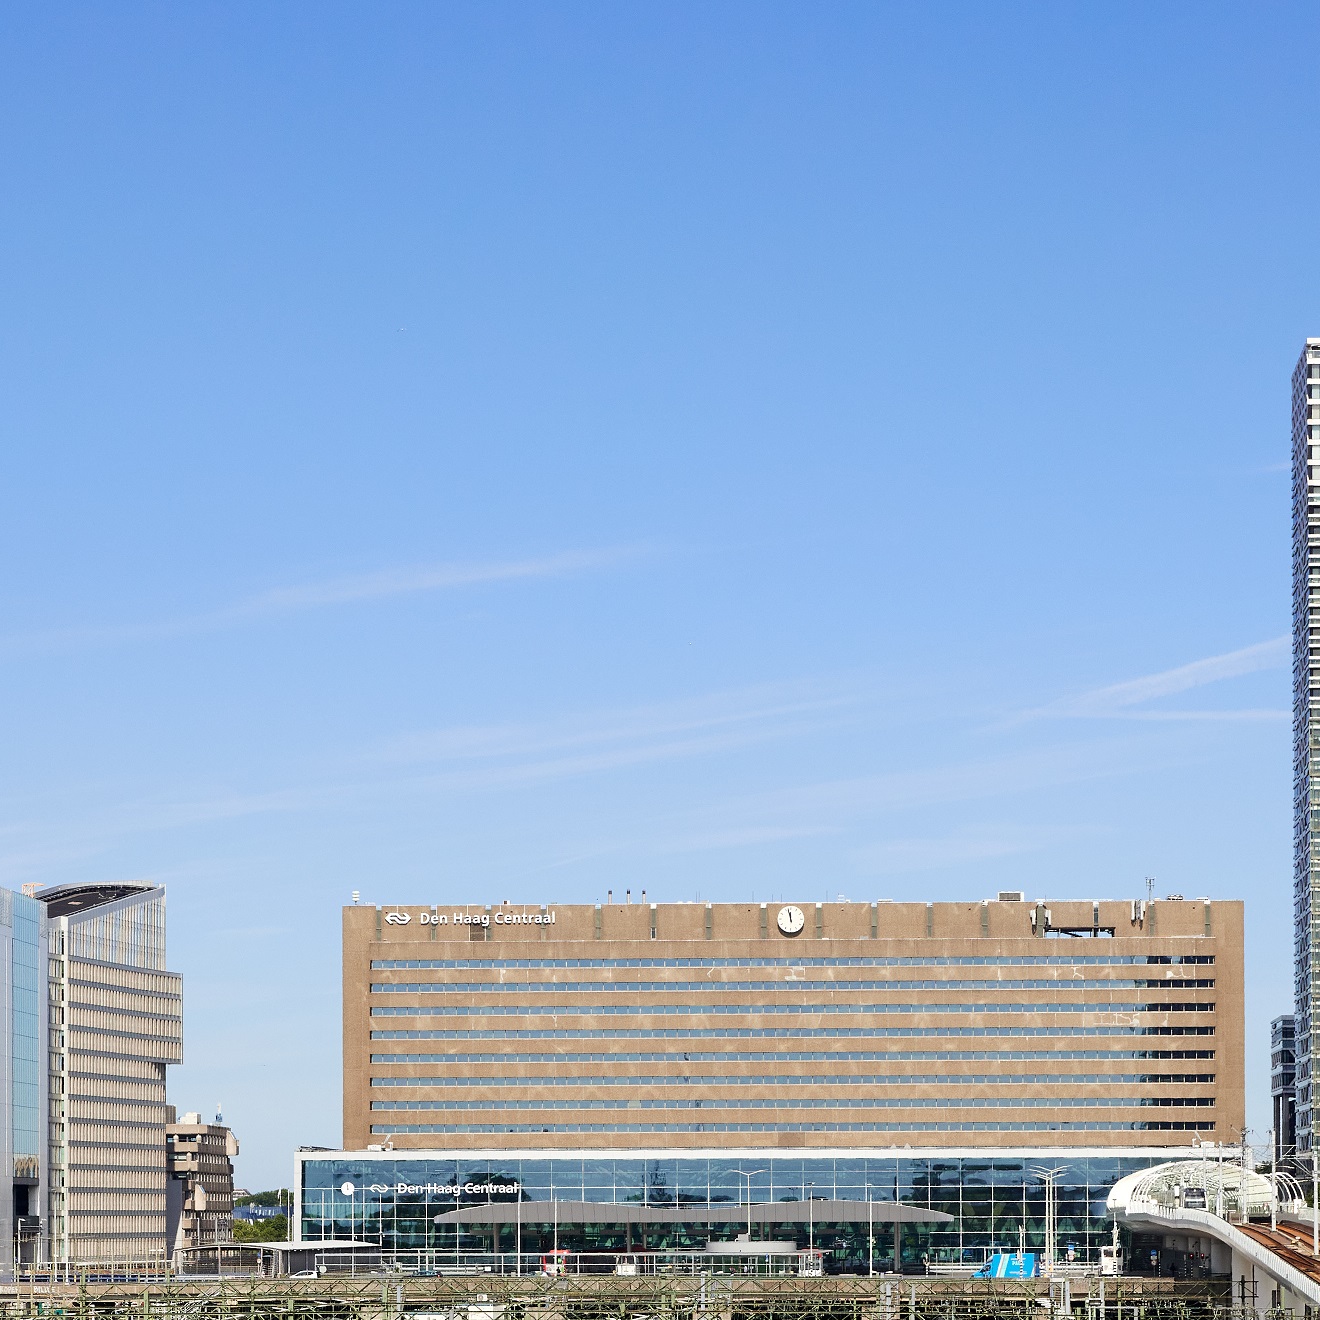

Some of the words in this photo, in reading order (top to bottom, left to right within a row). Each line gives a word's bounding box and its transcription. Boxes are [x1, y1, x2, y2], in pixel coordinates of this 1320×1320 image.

[420, 911, 448, 925] Den
[453, 911, 490, 927] Haag
[494, 911, 556, 925] Centraal
[397, 1182, 424, 1195] Den
[427, 1182, 461, 1197] Haag
[464, 1182, 520, 1194] Centraal
